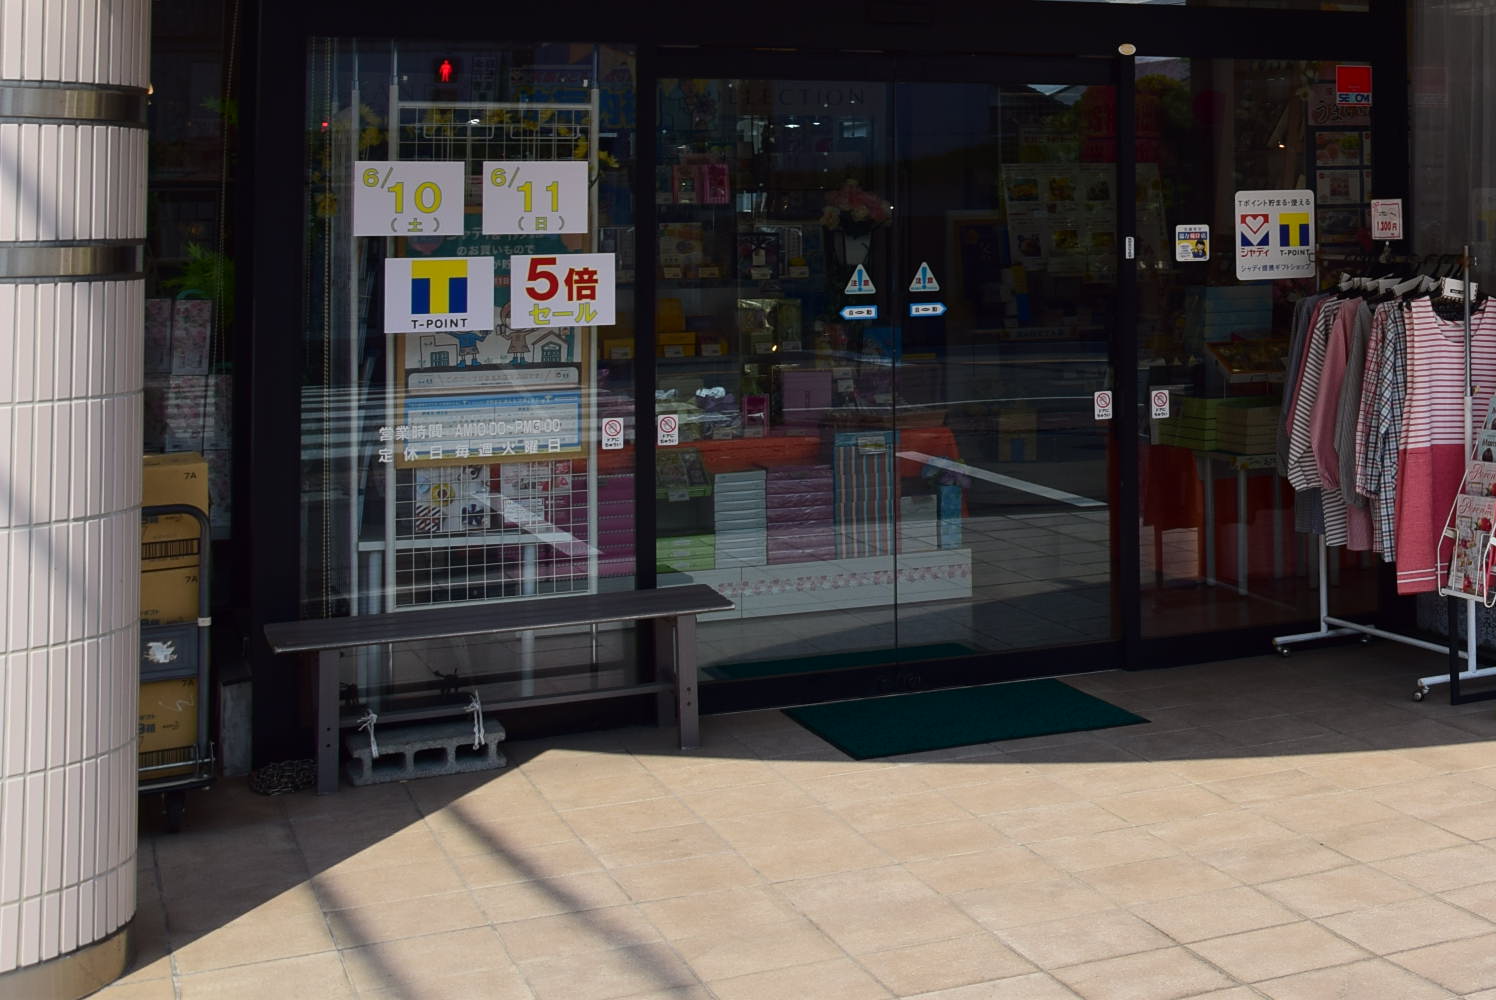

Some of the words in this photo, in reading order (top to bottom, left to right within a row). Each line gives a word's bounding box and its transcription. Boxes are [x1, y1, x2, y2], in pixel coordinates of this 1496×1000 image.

[1338, 93, 1370, 103] SEOM
[362, 167, 442, 214] 6/10
[490, 167, 560, 213] 6/11
[1240, 247, 1270, 258] シャディ
[525, 257, 599, 302] 5倍
[411, 318, 468, 329] T-POINT
[529, 303, 598, 325] セール
[378, 424, 443, 442] 営業時間
[378, 445, 443, 463] 定休日
[455, 438, 561, 459] 毎週火曜日
